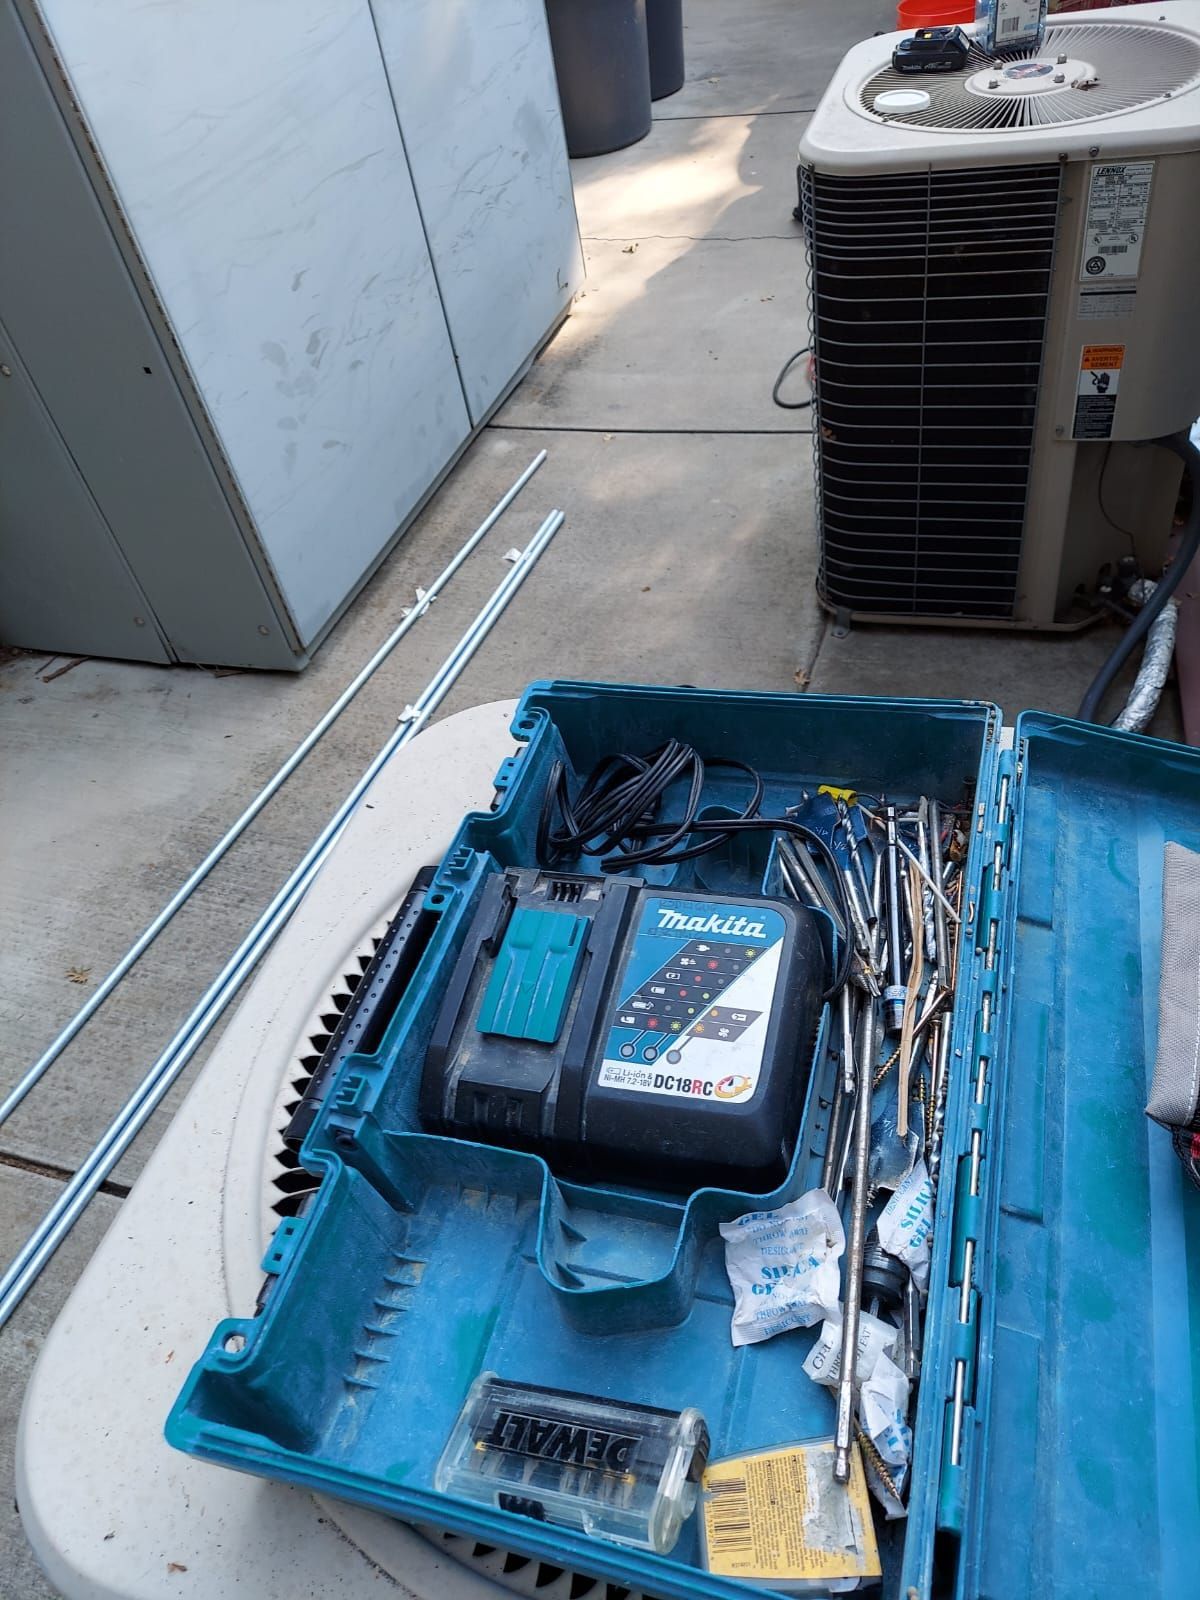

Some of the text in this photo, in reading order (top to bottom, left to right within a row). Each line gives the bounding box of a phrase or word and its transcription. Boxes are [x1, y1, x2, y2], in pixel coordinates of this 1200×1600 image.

[1096, 166, 1127, 175] LENNOX
[654, 1074, 714, 1096] DC18RC
[489, 1410, 641, 1472] DEWALT
